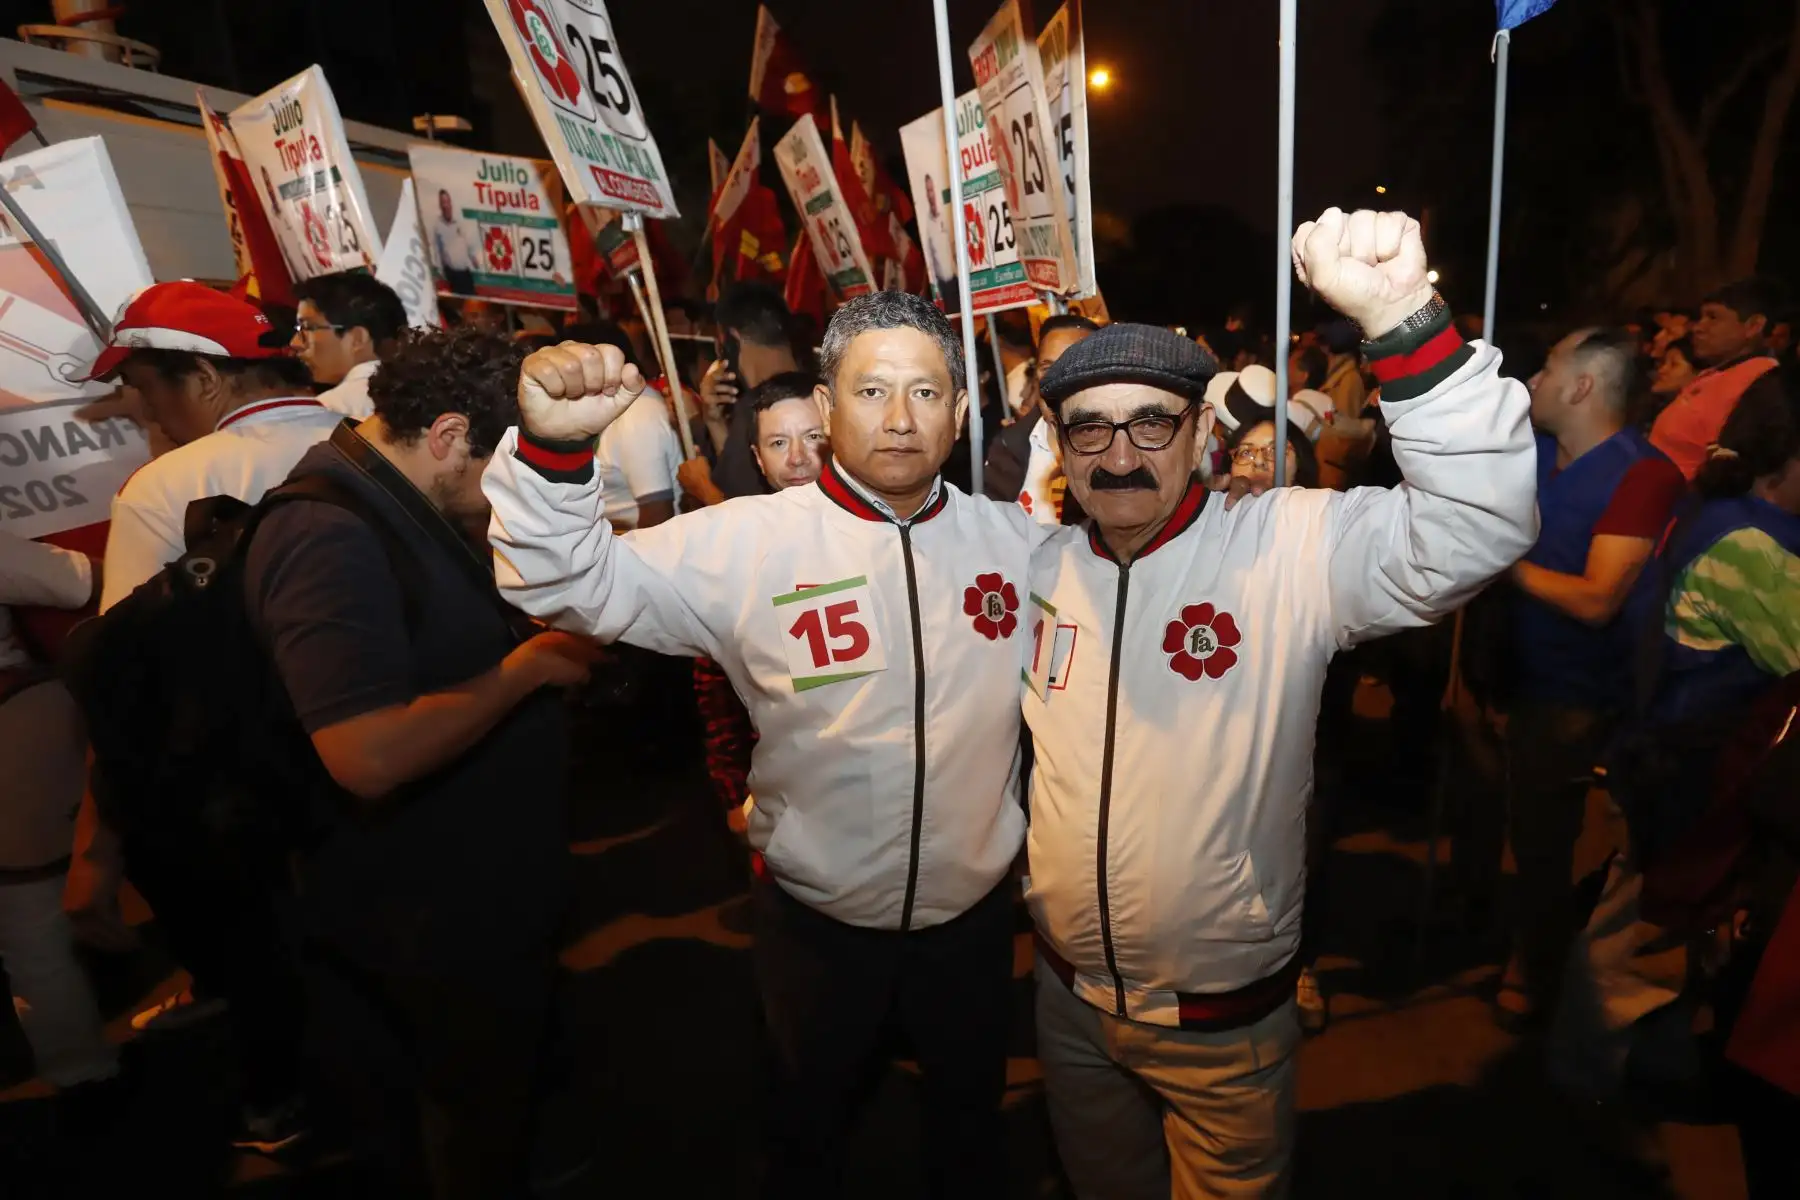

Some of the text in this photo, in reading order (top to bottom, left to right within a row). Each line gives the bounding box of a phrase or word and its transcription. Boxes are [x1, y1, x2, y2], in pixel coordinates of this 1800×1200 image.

[566, 23, 630, 115] 25
[269, 93, 303, 136] Julio
[956, 101, 984, 136] ulio
[274, 129, 323, 177] Tipula
[477, 158, 529, 186] Julio
[961, 132, 997, 179] pula
[1012, 112, 1044, 195] 25
[474, 182, 540, 214] Tipula
[326, 202, 359, 254] 25
[988, 201, 1016, 252] 25
[522, 236, 554, 271] 25
[984, 594, 1005, 617] fa
[788, 599, 871, 669] 15
[1190, 628, 1215, 655] fa
